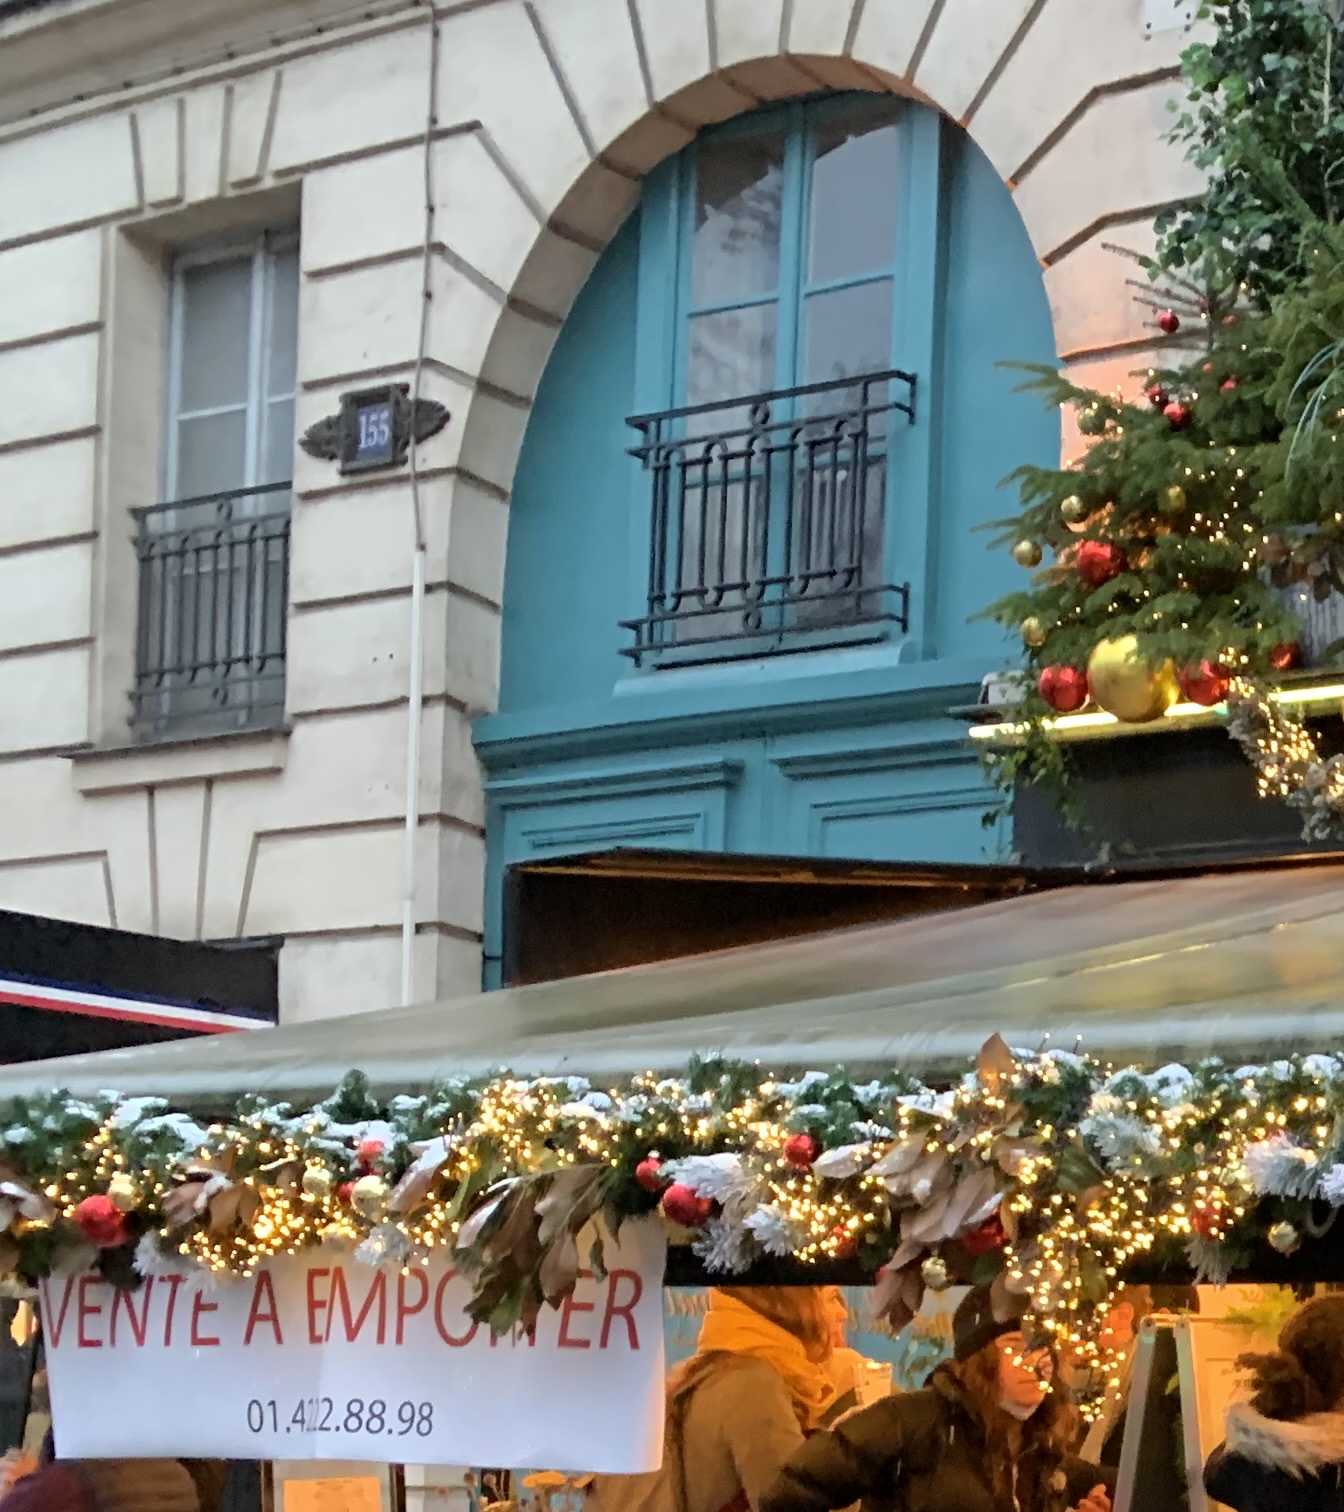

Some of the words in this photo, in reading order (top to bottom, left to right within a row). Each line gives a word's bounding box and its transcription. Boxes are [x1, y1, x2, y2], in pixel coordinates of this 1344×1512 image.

[357, 409, 390, 449] 155
[41, 1273, 221, 1348] VENTE
[306, 1266, 643, 1350] EMPOER
